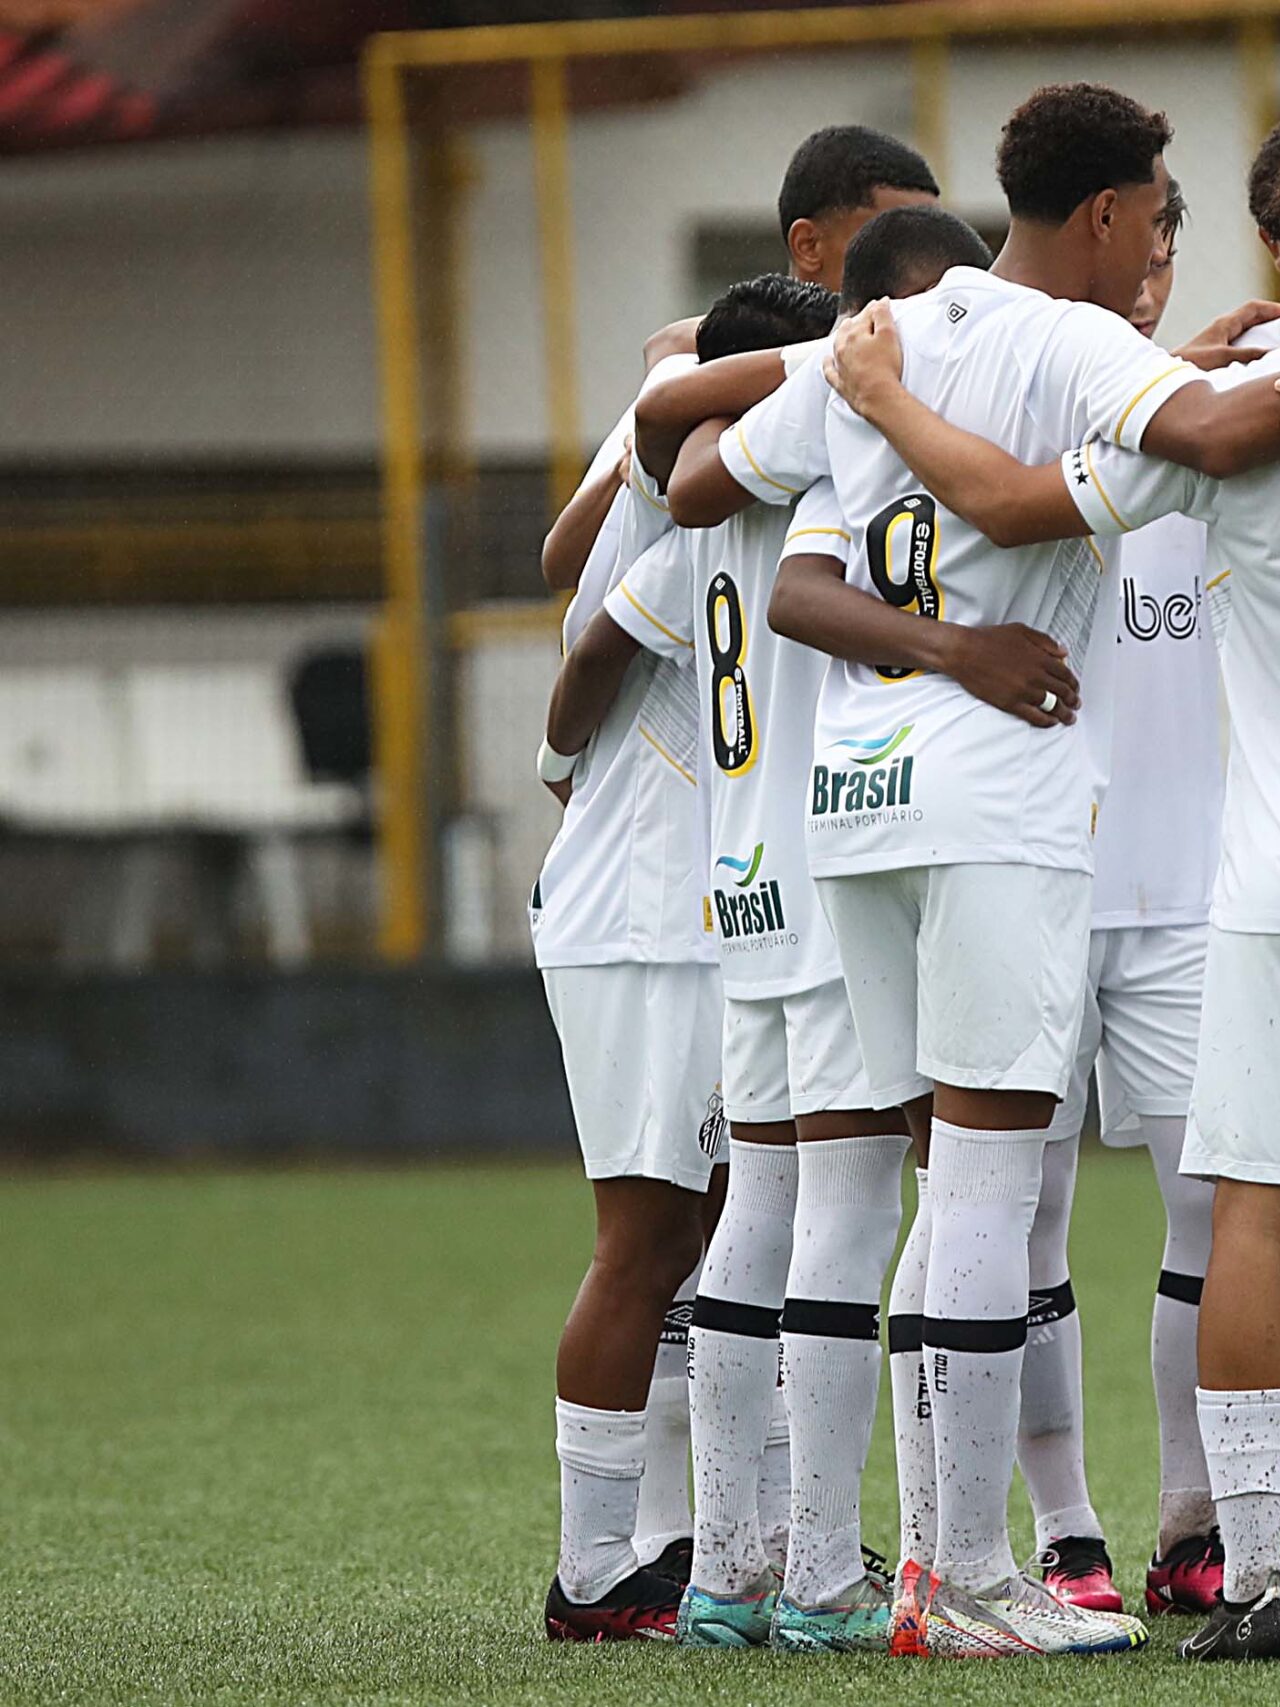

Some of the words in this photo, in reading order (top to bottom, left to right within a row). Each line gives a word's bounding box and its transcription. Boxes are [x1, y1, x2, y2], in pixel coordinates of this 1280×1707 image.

[866, 493, 946, 684] 9
[706, 571, 760, 779] 8
[812, 755, 914, 816] Brasil
[855, 808, 924, 828] PORTUÁRIO
[714, 879, 785, 939] Brasil
